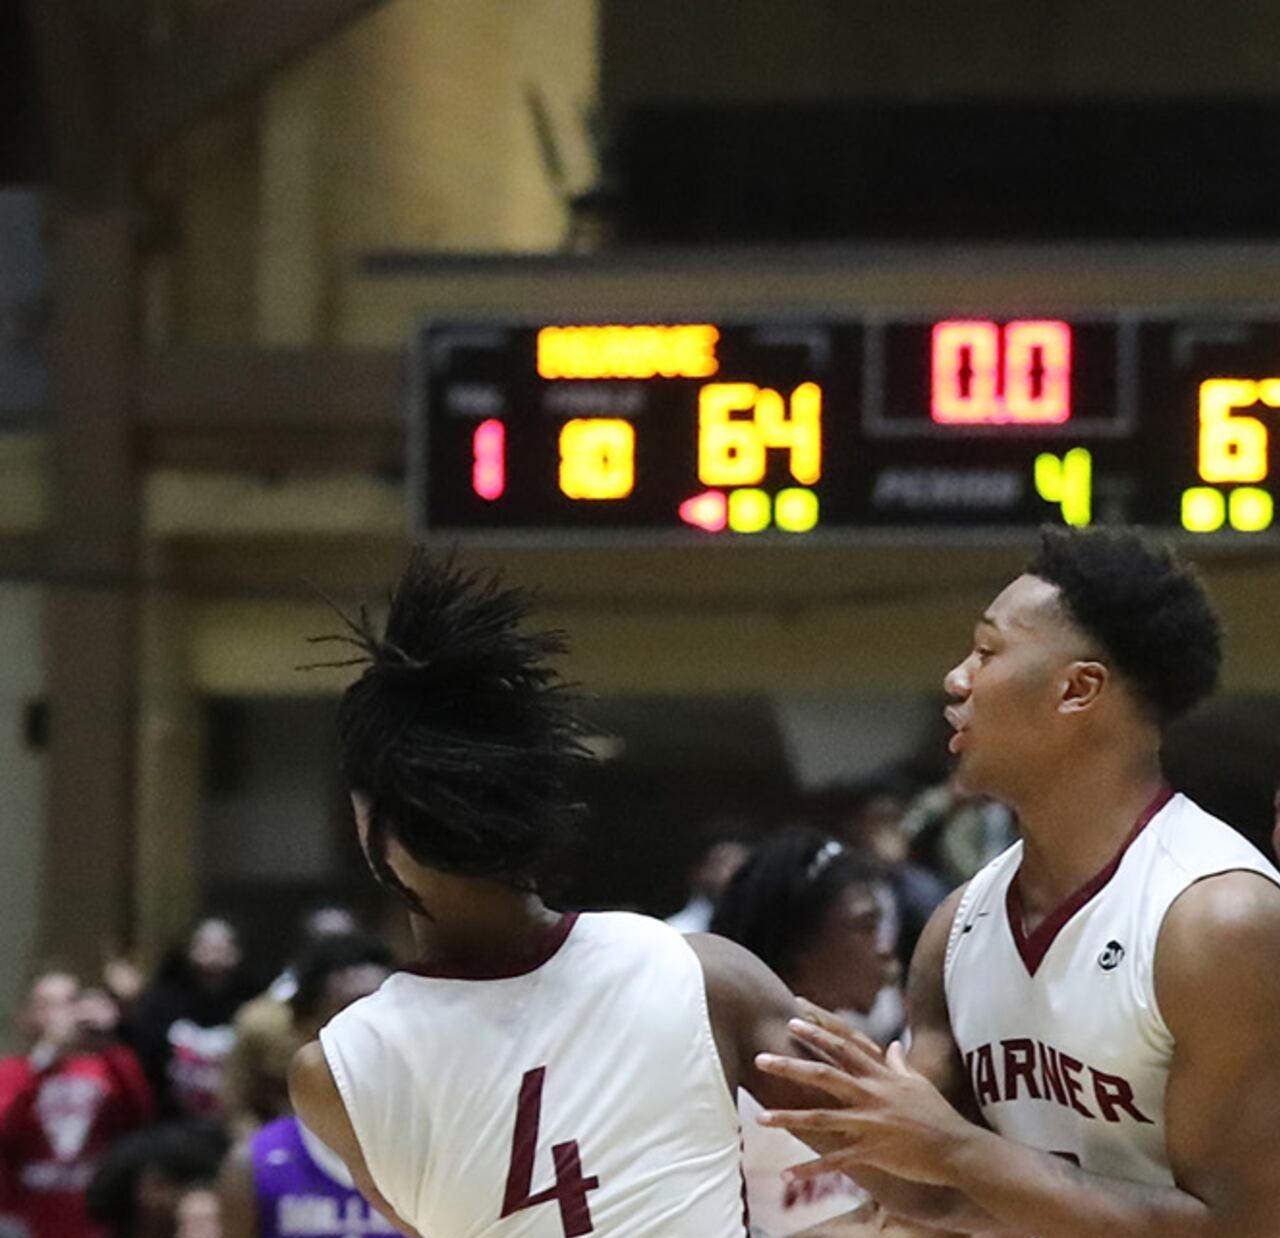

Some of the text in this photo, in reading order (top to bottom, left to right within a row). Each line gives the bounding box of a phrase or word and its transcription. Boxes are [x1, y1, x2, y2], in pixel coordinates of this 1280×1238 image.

[473, 419, 504, 499] 1
[698, 383, 821, 485] 64
[1035, 447, 1092, 527] 4
